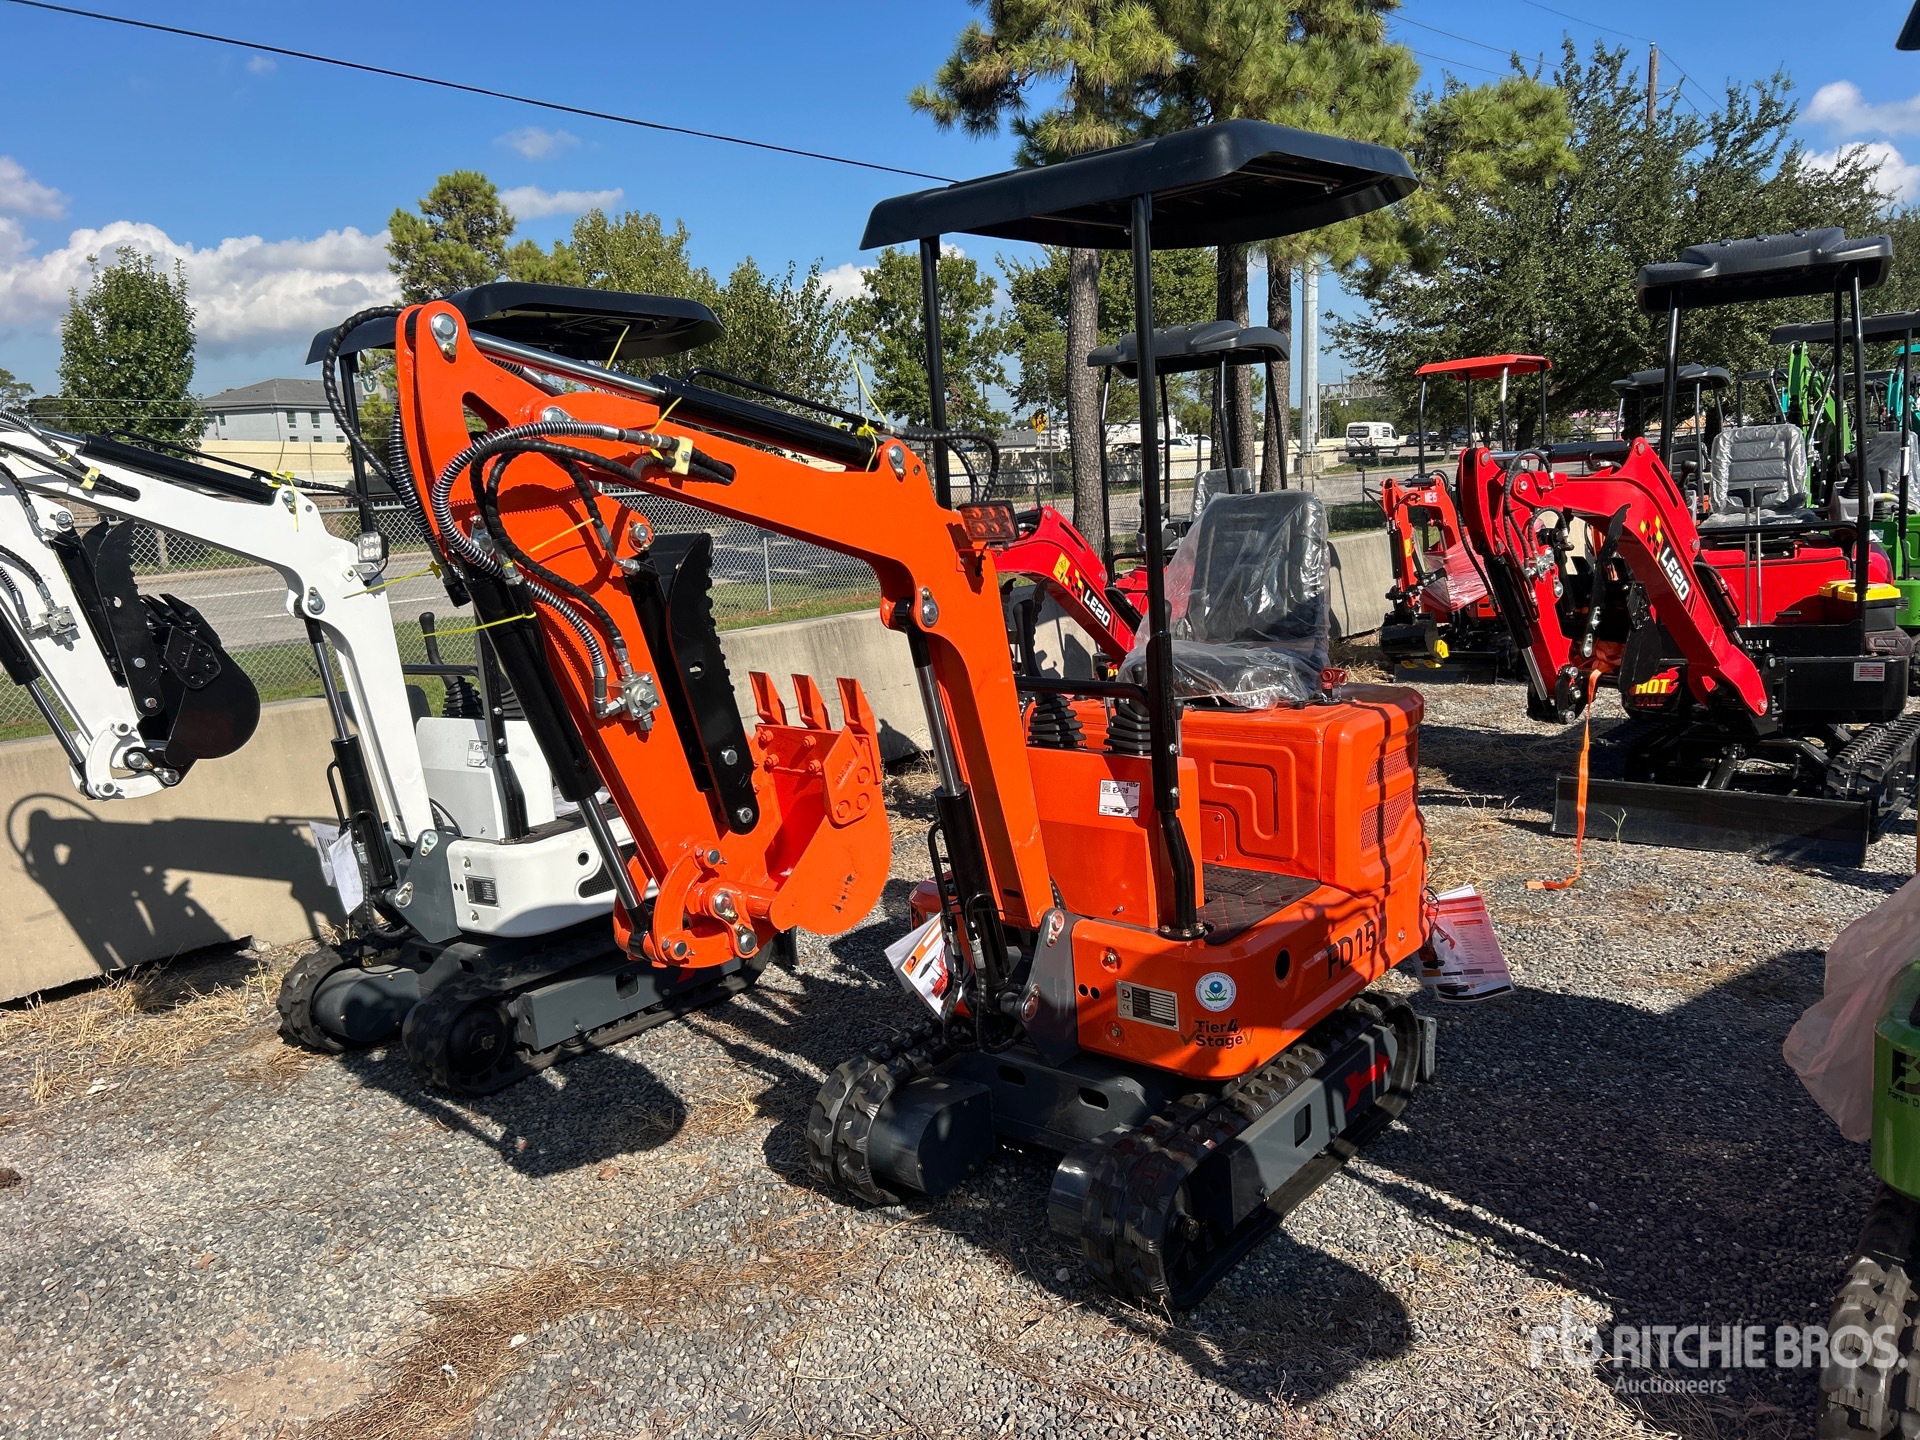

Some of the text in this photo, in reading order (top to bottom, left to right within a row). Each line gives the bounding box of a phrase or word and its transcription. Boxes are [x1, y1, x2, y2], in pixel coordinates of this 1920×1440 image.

[1660, 546, 1690, 601] LE20
[1084, 589, 1111, 627] LE20
[1635, 679, 1671, 695] HOT
[1325, 919, 1377, 980] FD15
[1195, 1034, 1243, 1050] Stage
